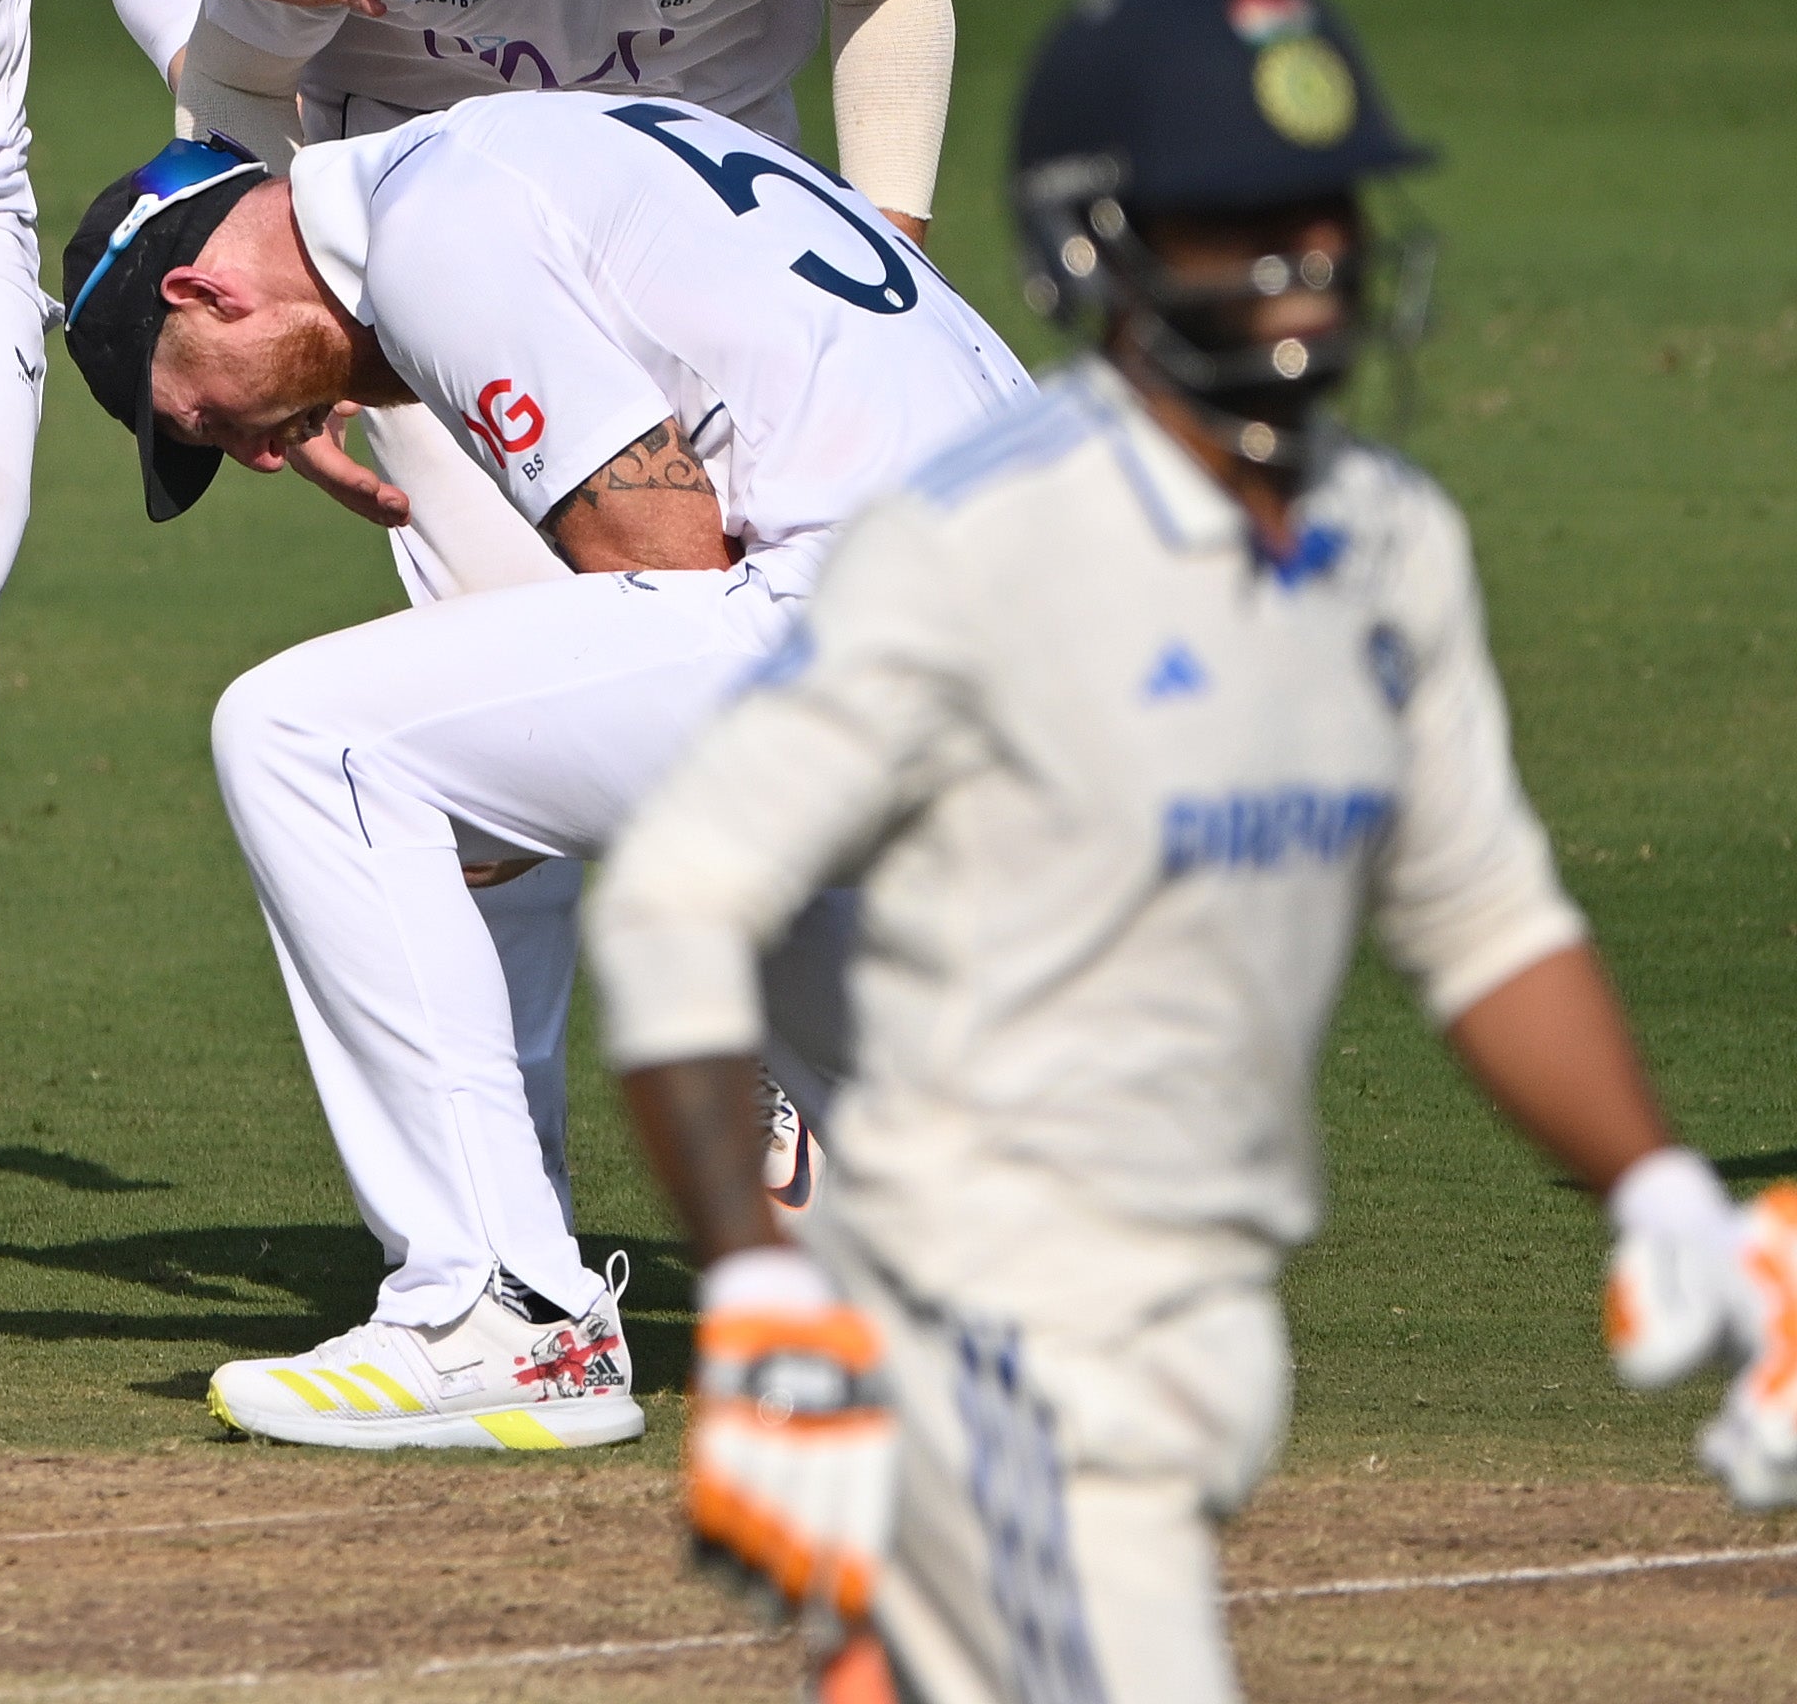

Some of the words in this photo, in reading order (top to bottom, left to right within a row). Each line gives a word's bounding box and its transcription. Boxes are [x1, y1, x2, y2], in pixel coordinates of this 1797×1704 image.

[461, 379, 545, 469] IG
[521, 453, 545, 482] BS
[583, 1374, 625, 1386] adidas
